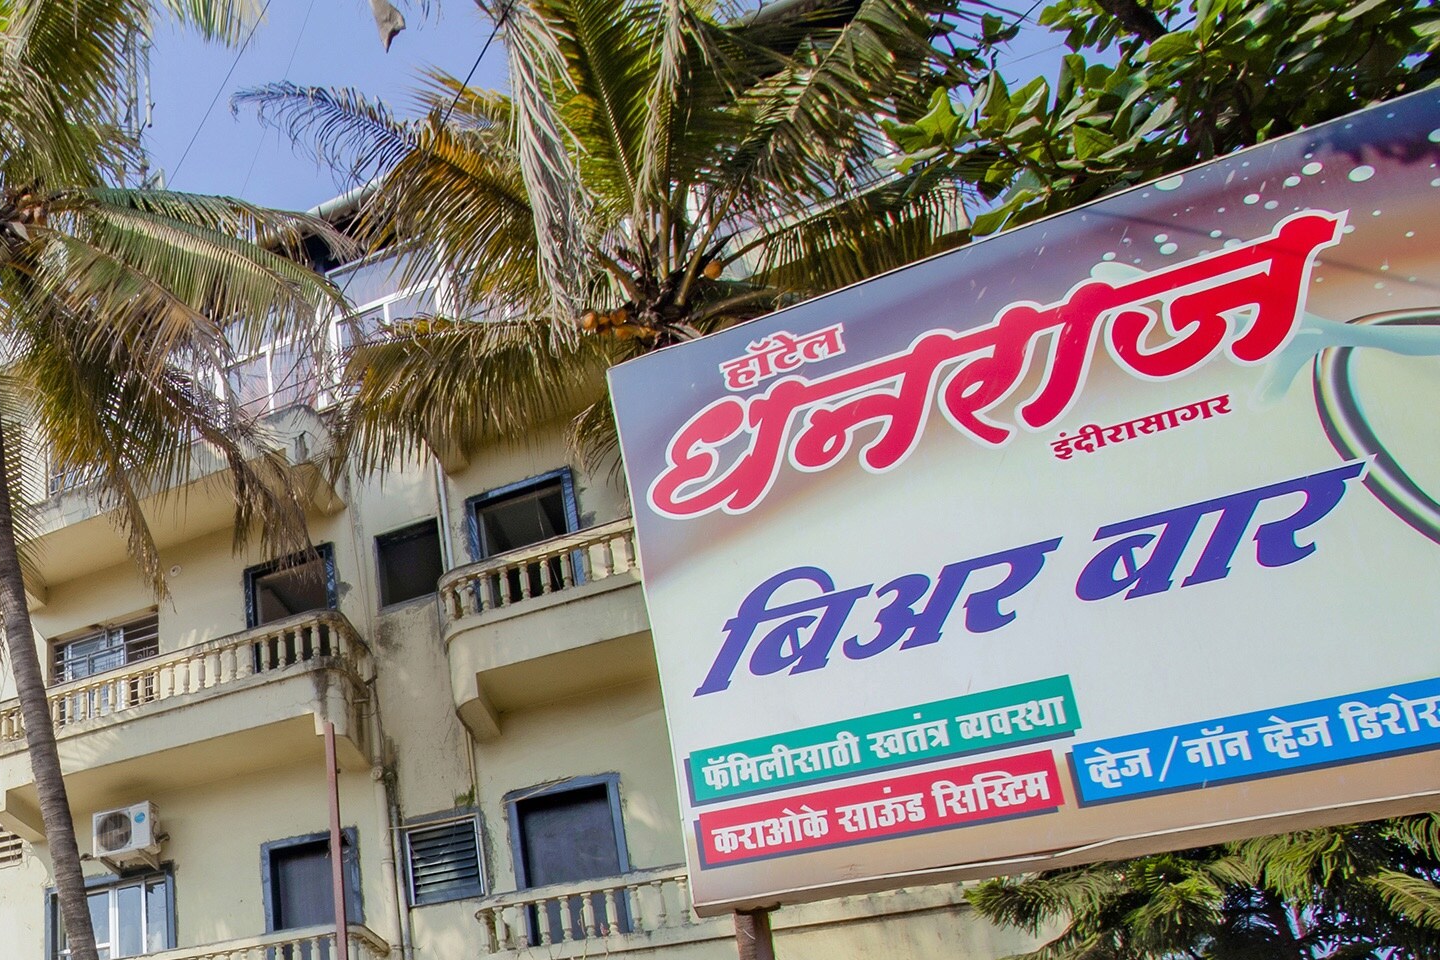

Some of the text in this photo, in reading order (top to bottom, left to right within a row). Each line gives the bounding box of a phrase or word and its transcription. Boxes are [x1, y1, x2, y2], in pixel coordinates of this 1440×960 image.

[650, 211, 1347, 517] धनराज
[721, 323, 844, 390] हॉटेल
[1050, 394, 1233, 460] इंदीरासागर
[693, 456, 1368, 698] बिअर बार
[702, 696, 1068, 791] फॅमिलीसाठी स्वतंत्र व्यवस्था
[1084, 746, 1153, 789] व्हेज
[1182, 725, 1252, 768] नॉन
[1258, 715, 1334, 760] व्हेज
[711, 770, 1051, 855] कराओके साऊंड सिस्टिम
